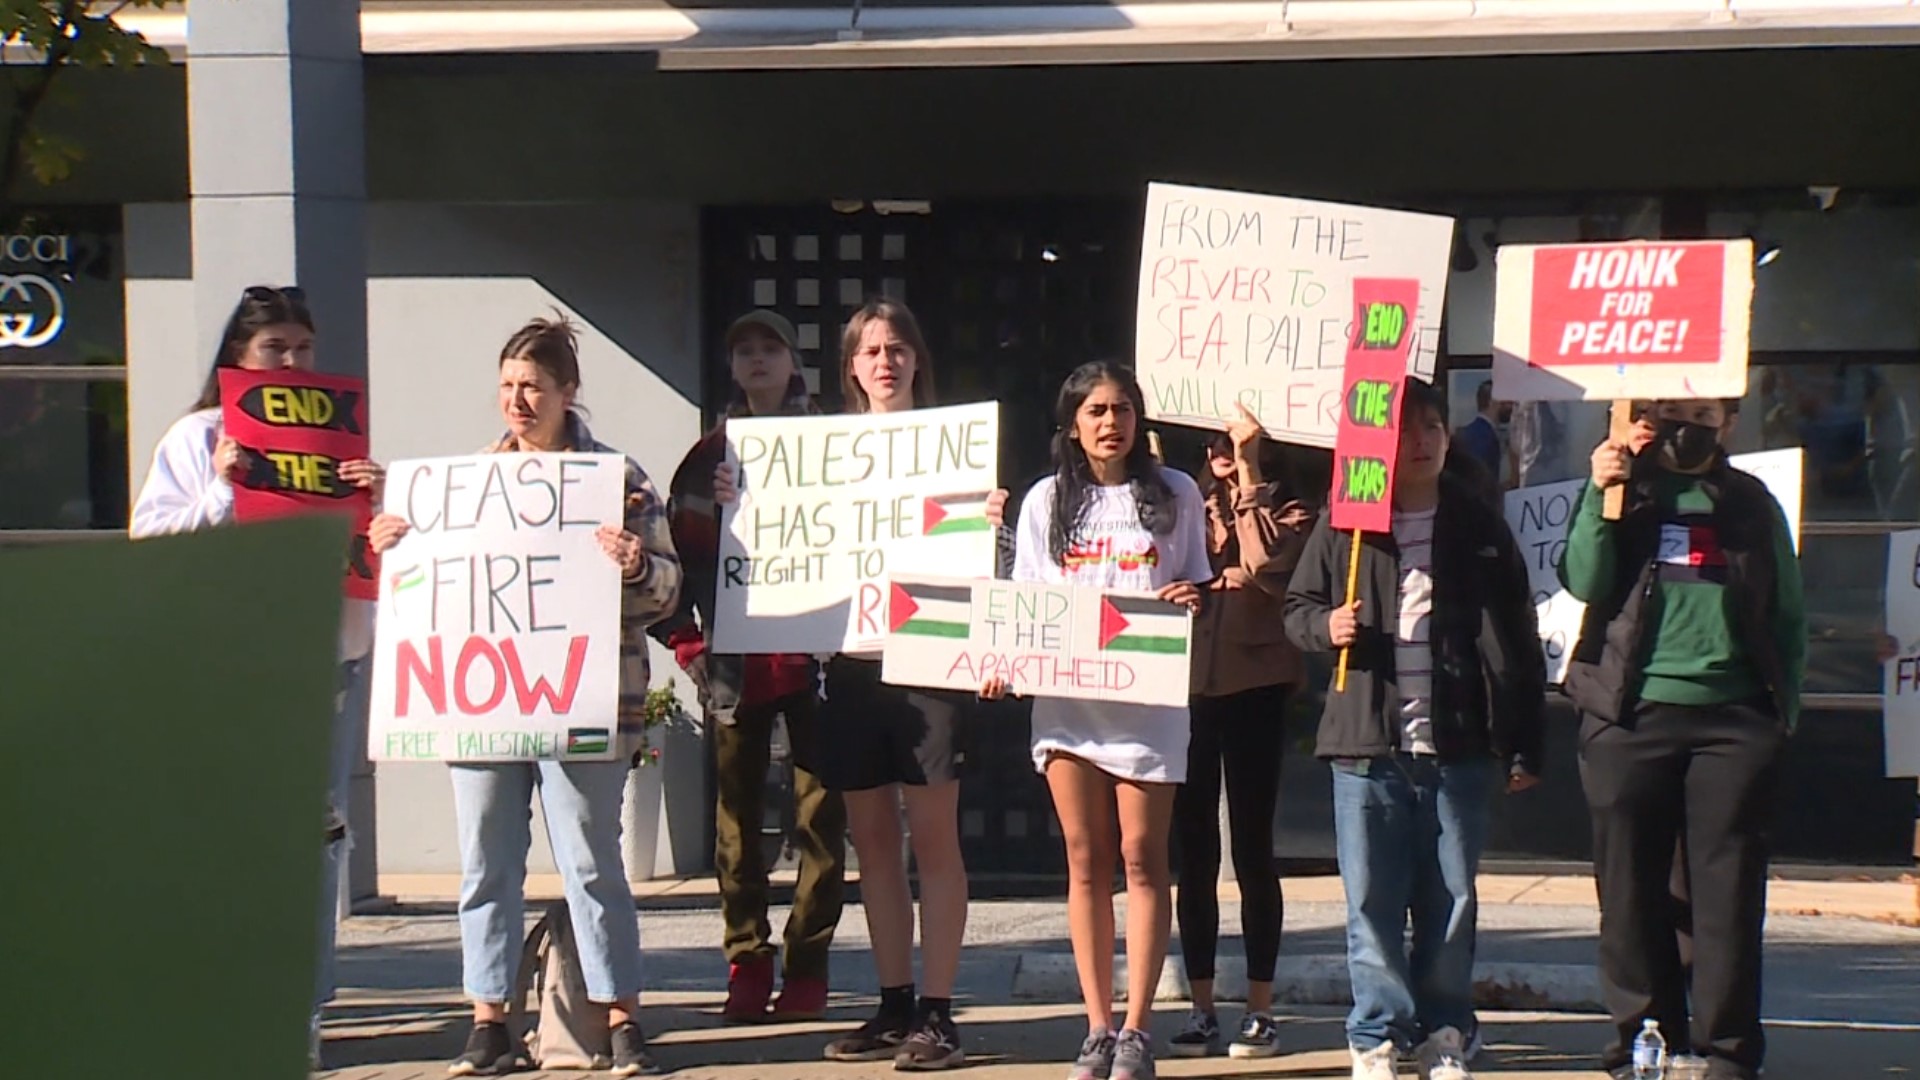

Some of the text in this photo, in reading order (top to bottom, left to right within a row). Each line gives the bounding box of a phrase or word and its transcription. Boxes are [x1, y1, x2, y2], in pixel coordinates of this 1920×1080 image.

[0, 235, 68, 262] CCI
[1160, 199, 1370, 261] FROM THE
[1151, 256, 1326, 307] RIVER TO
[1569, 248, 1687, 290] HONK
[1365, 302, 1405, 346] END
[1600, 291, 1654, 318] FOR
[1558, 319, 1690, 356] PEACE!
[262, 386, 334, 425] END
[1150, 373, 1232, 418] WILL
[1356, 379, 1391, 428] THE
[267, 452, 334, 494] THE
[736, 420, 989, 490] PALESTINE
[407, 458, 601, 534] CEASE
[1347, 457, 1388, 503] WARS
[754, 494, 916, 551] HAS THE
[1520, 494, 1571, 533] NO
[724, 548, 886, 589] RIGHT TO
[431, 554, 568, 634] FIRE
[987, 588, 1069, 622] END
[983, 618, 1062, 650] THE
[394, 634, 590, 719] NOW
[945, 650, 1136, 690] APARTHEID
[385, 730, 438, 758] FREE
